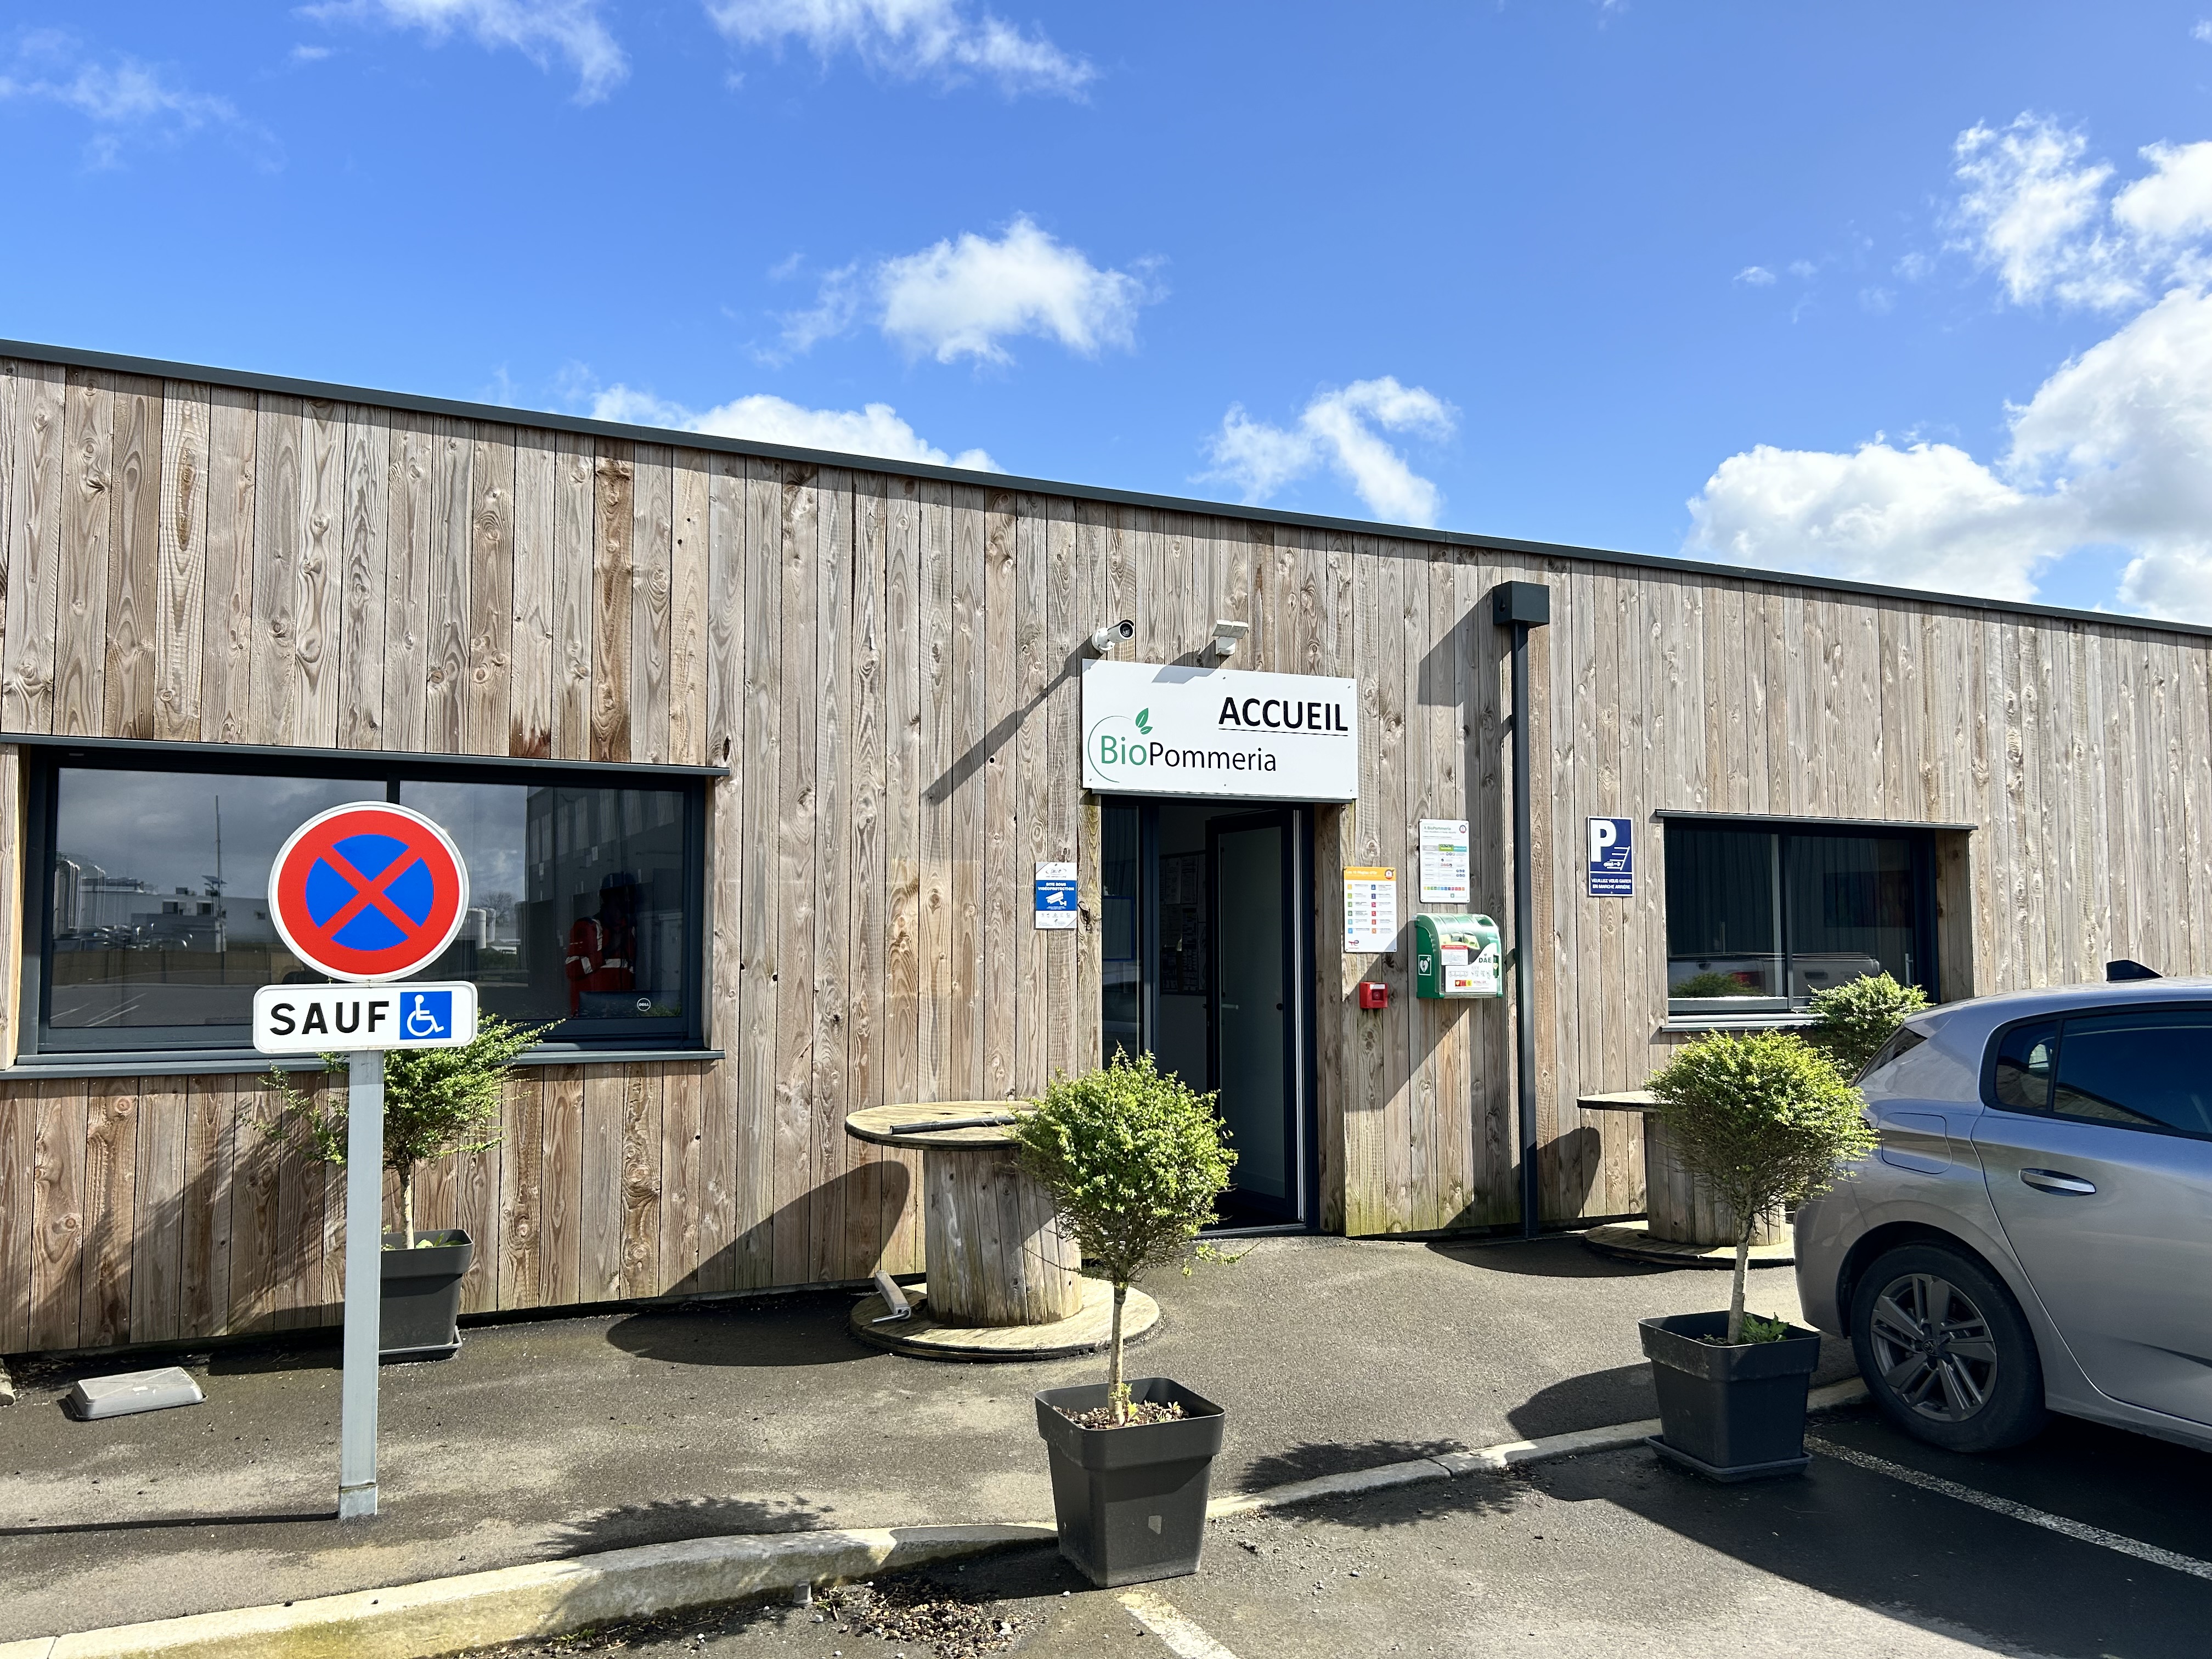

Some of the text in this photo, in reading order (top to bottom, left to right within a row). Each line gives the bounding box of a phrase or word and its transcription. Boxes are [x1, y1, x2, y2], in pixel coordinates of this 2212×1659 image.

[1218, 697, 1348, 731] ACCUEIL
[1101, 735, 1276, 771] BioPommeria
[1590, 819, 1617, 862] P
[269, 1001, 390, 1036] SAUF
